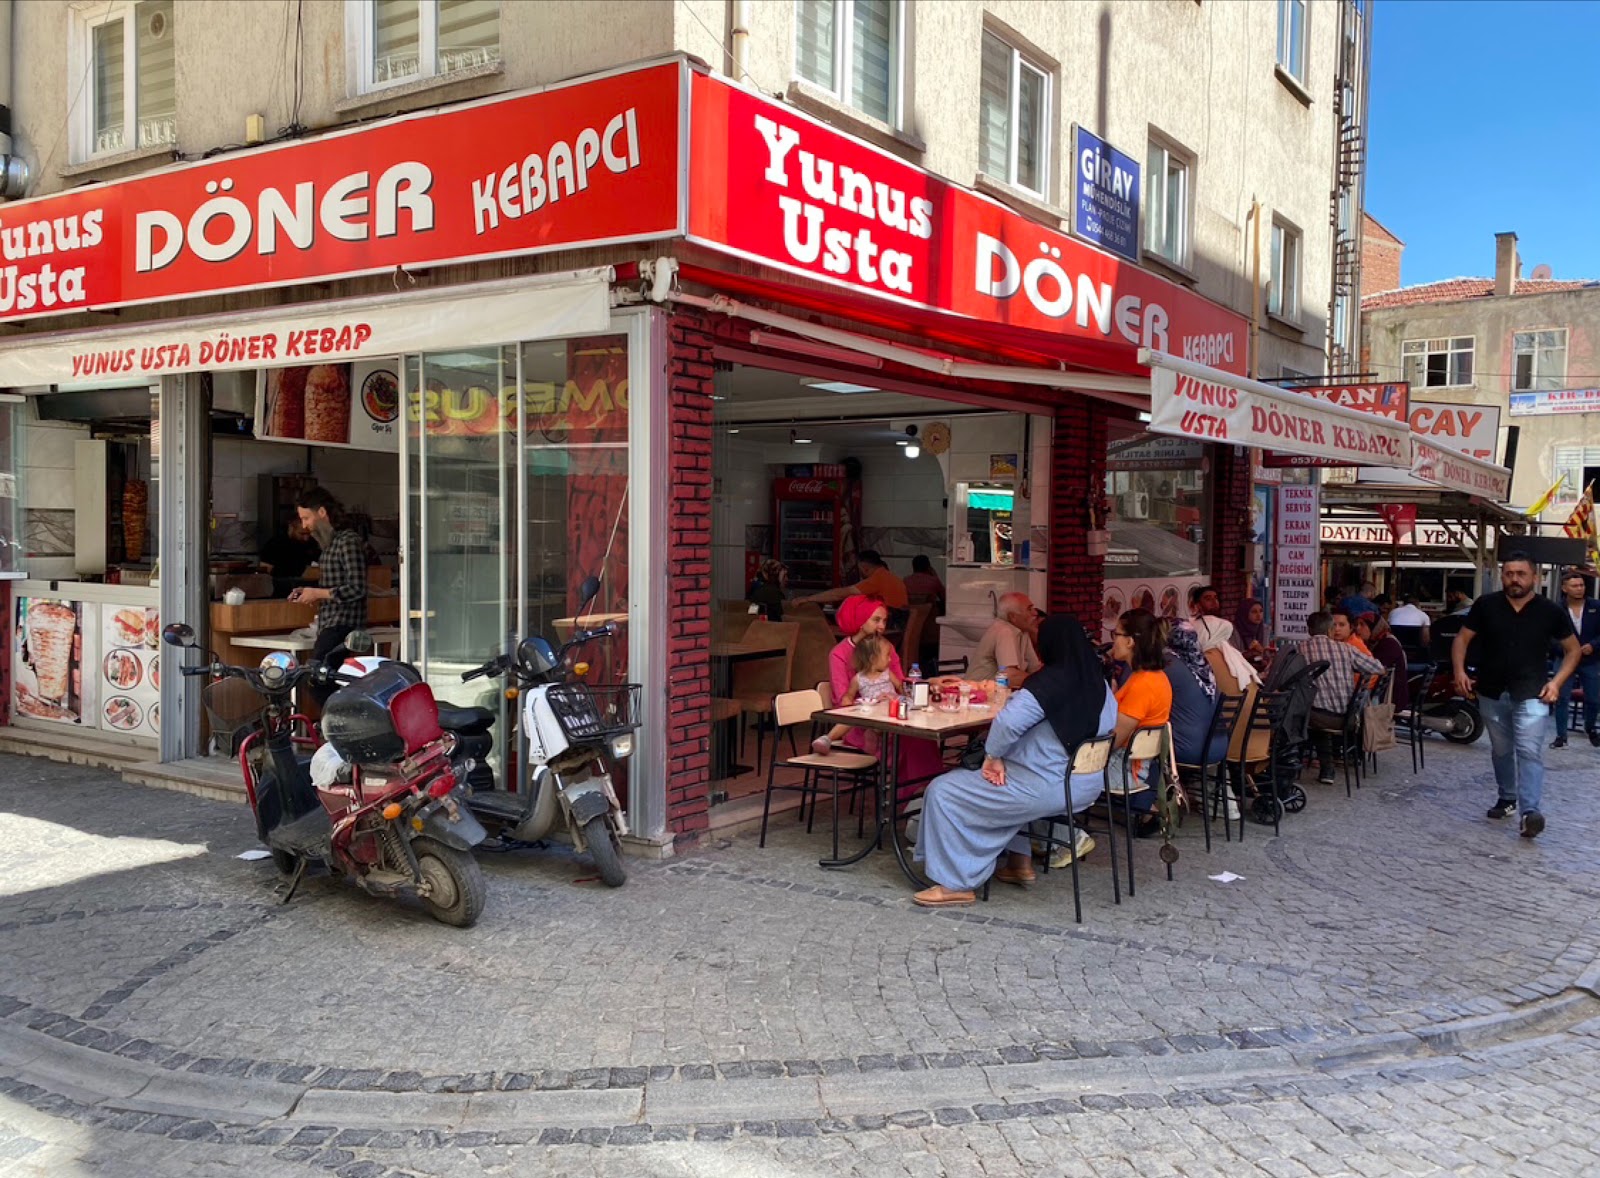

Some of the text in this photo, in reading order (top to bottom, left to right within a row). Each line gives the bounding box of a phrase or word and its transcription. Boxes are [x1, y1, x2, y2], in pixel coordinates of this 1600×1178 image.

[136, 107, 640, 272] DÖNER KEBAPCI
[755, 114, 933, 239] Yunus
[1081, 147, 1133, 201] GİRAY
[0, 208, 103, 261] unus
[779, 194, 912, 294] Usta
[975, 231, 1234, 366] DÖNER KEBAPCI
[72, 323, 372, 377] YUNUS USTA DÖNER KEBAP
[1174, 372, 1237, 409] YUNUS
[1180, 410, 1227, 439] USTA
[1251, 403, 1325, 445] DÖNER
[1291, 456, 1317, 464] 0537
[1285, 487, 1313, 498] TEKNİK
[1285, 502, 1311, 513] SERVİS
[1285, 520, 1311, 530] EKRAN
[1288, 550, 1305, 560] CAM
[1282, 590, 1309, 599] TELEFON
